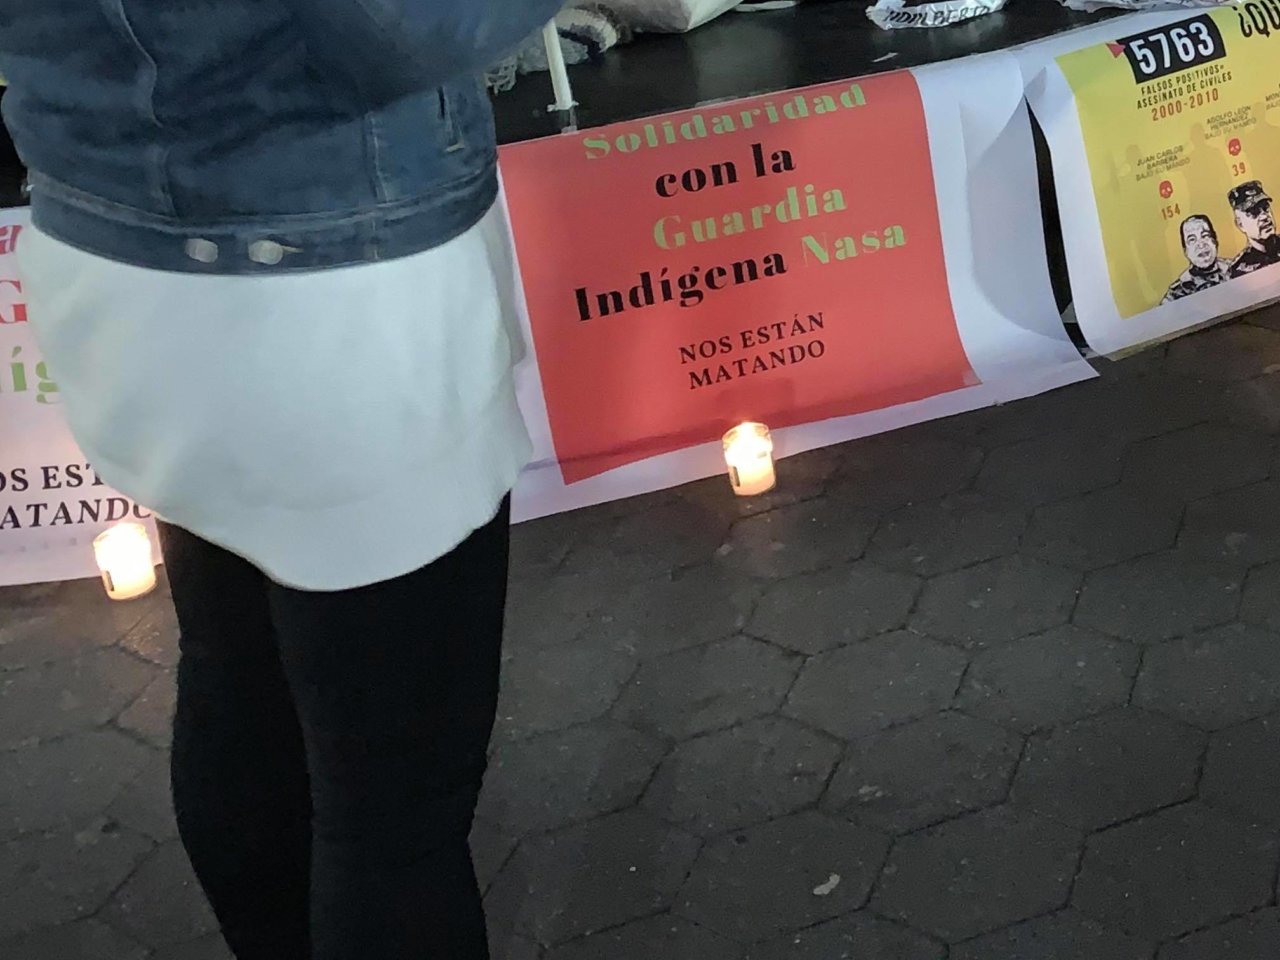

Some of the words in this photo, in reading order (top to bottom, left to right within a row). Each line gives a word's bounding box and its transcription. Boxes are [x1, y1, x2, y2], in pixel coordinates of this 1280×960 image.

[1129, 21, 1215, 74] 5763
[1137, 89, 1184, 110] ASESINATO
[1186, 82, 1197, 94] DE
[1200, 71, 1233, 90] CIVILES
[1141, 78, 1173, 95] FALSOS
[1151, 87, 1219, 121] 2000-2010
[582, 83, 867, 160] Solidaridad
[1206, 111, 1233, 125] ADOLFO
[655, 159, 739, 198] con
[751, 142, 797, 177] la
[1232, 162, 1246, 177] 39
[653, 183, 848, 251] Guardia
[1161, 203, 1181, 220] 154
[573, 251, 788, 322] Indígena
[801, 224, 908, 267] Nasa
[678, 335, 733, 365] NOS
[739, 311, 825, 350] ESTÁN
[688, 339, 826, 390] MATANDO
